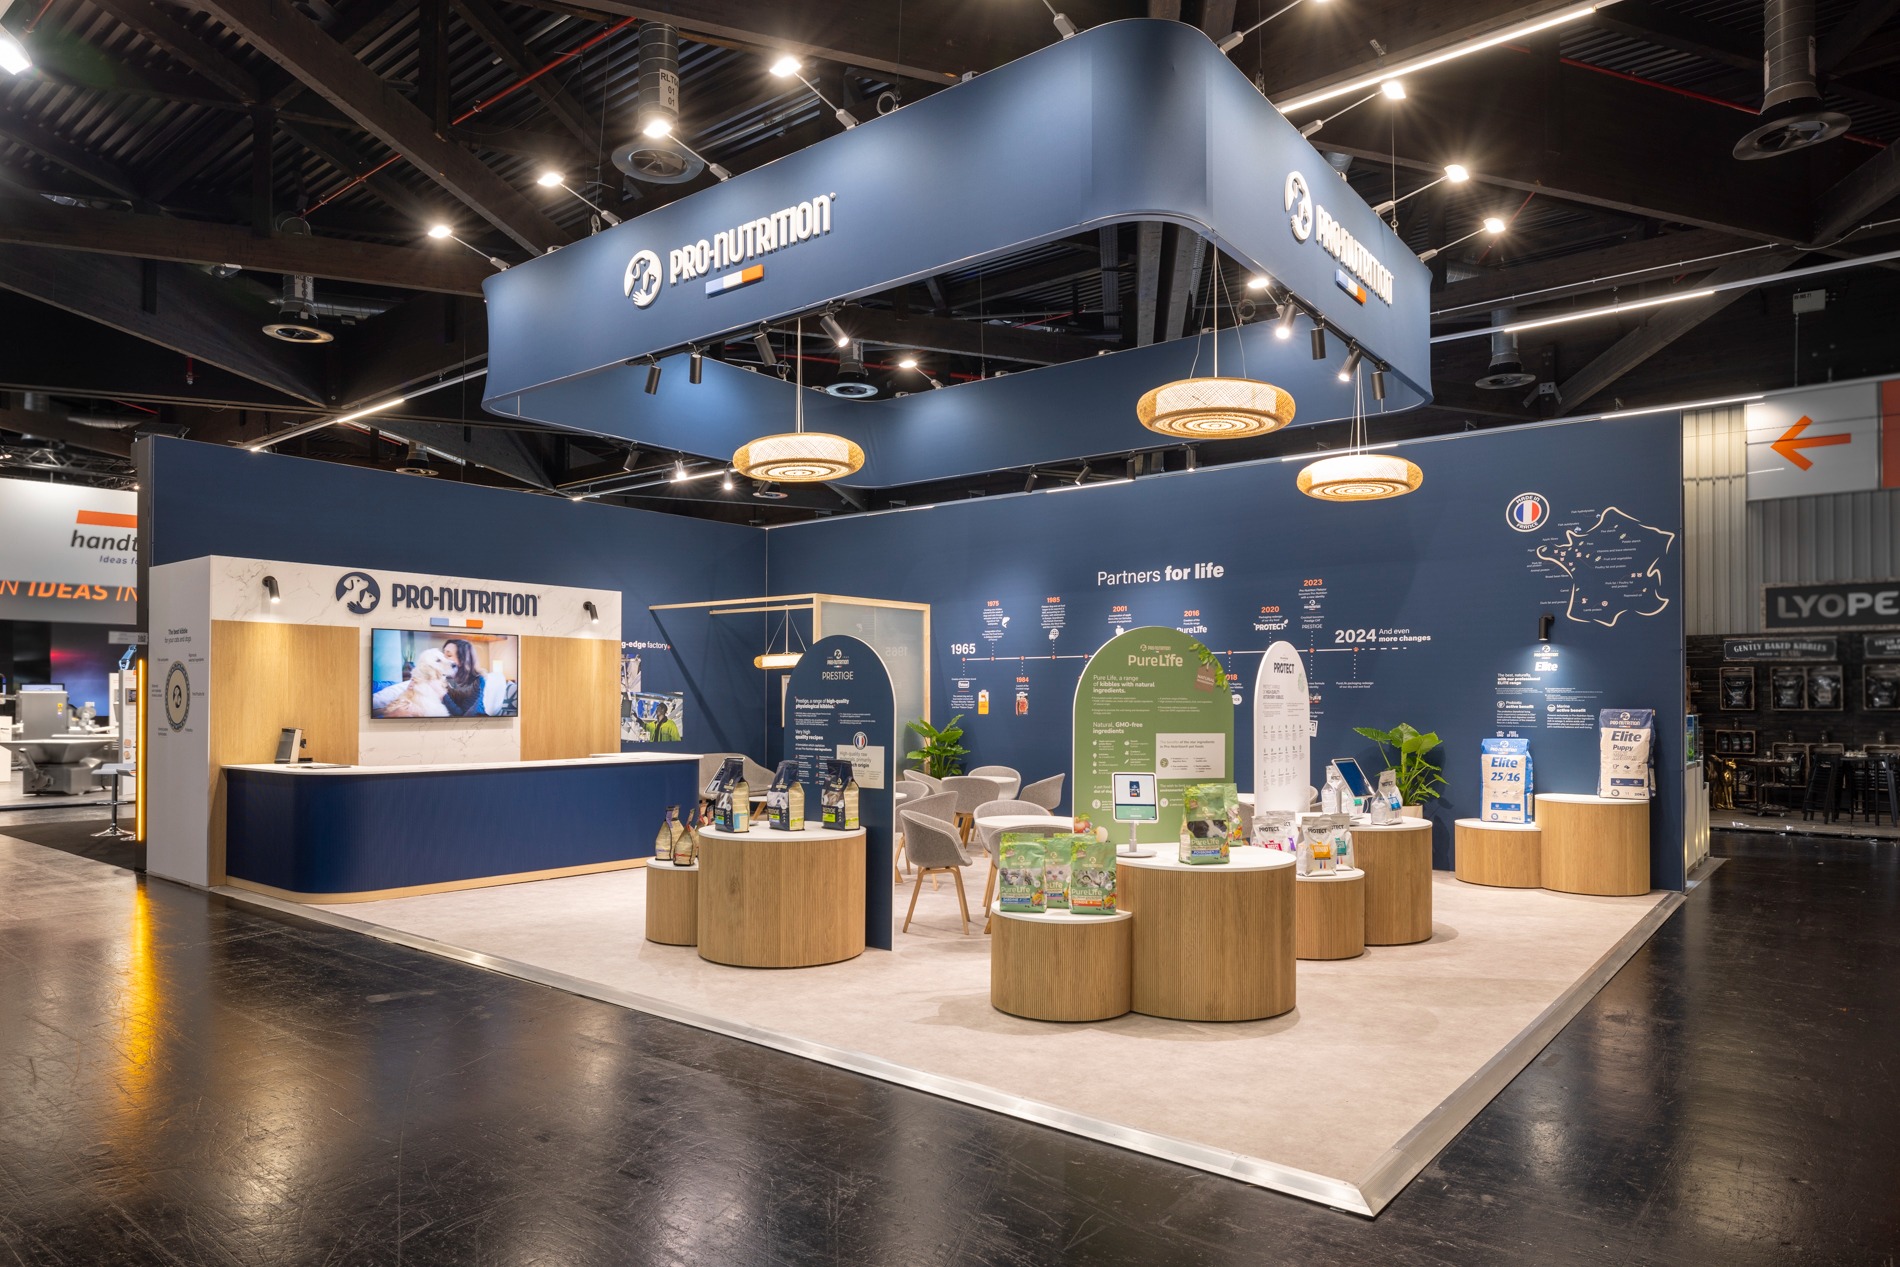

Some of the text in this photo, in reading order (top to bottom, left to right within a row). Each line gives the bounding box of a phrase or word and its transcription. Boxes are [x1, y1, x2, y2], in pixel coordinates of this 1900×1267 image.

[669, 194, 831, 285] PRO-NUTRITION
[1315, 204, 1393, 305] PRO-NUTRITION
[1515, 495, 1534, 504] MADE
[1516, 522, 1538, 530] FRANCE
[70, 529, 138, 552] handt
[99, 555, 128, 565] Ideas
[1097, 562, 1224, 586] Partners for life
[28, 581, 108, 601] IDEAS
[392, 583, 538, 617] PRO-NUTRITION
[1777, 591, 1900, 618] LYOPE
[1255, 623, 1285, 631] PROTECT
[1334, 629, 1377, 644] 2024
[950, 643, 976, 655] 1965
[1733, 642, 1827, 653] GENTLY BAKED KIBBLES
[1128, 654, 1183, 667] PureLife
[1273, 662, 1295, 674] PROTECT
[1534, 661, 1558, 672] Elite
[822, 671, 854, 680] PRESTIGE
[1225, 673, 1238, 681] 018
[1611, 731, 1642, 742] Elite
[1612, 744, 1634, 752] Puppy
[1491, 757, 1518, 768] Elite
[1491, 772, 1520, 782] 25/16
[1001, 886, 1031, 894] PureLife
[1045, 882, 1063, 890] eLife
[1071, 888, 1102, 896] PureLife
